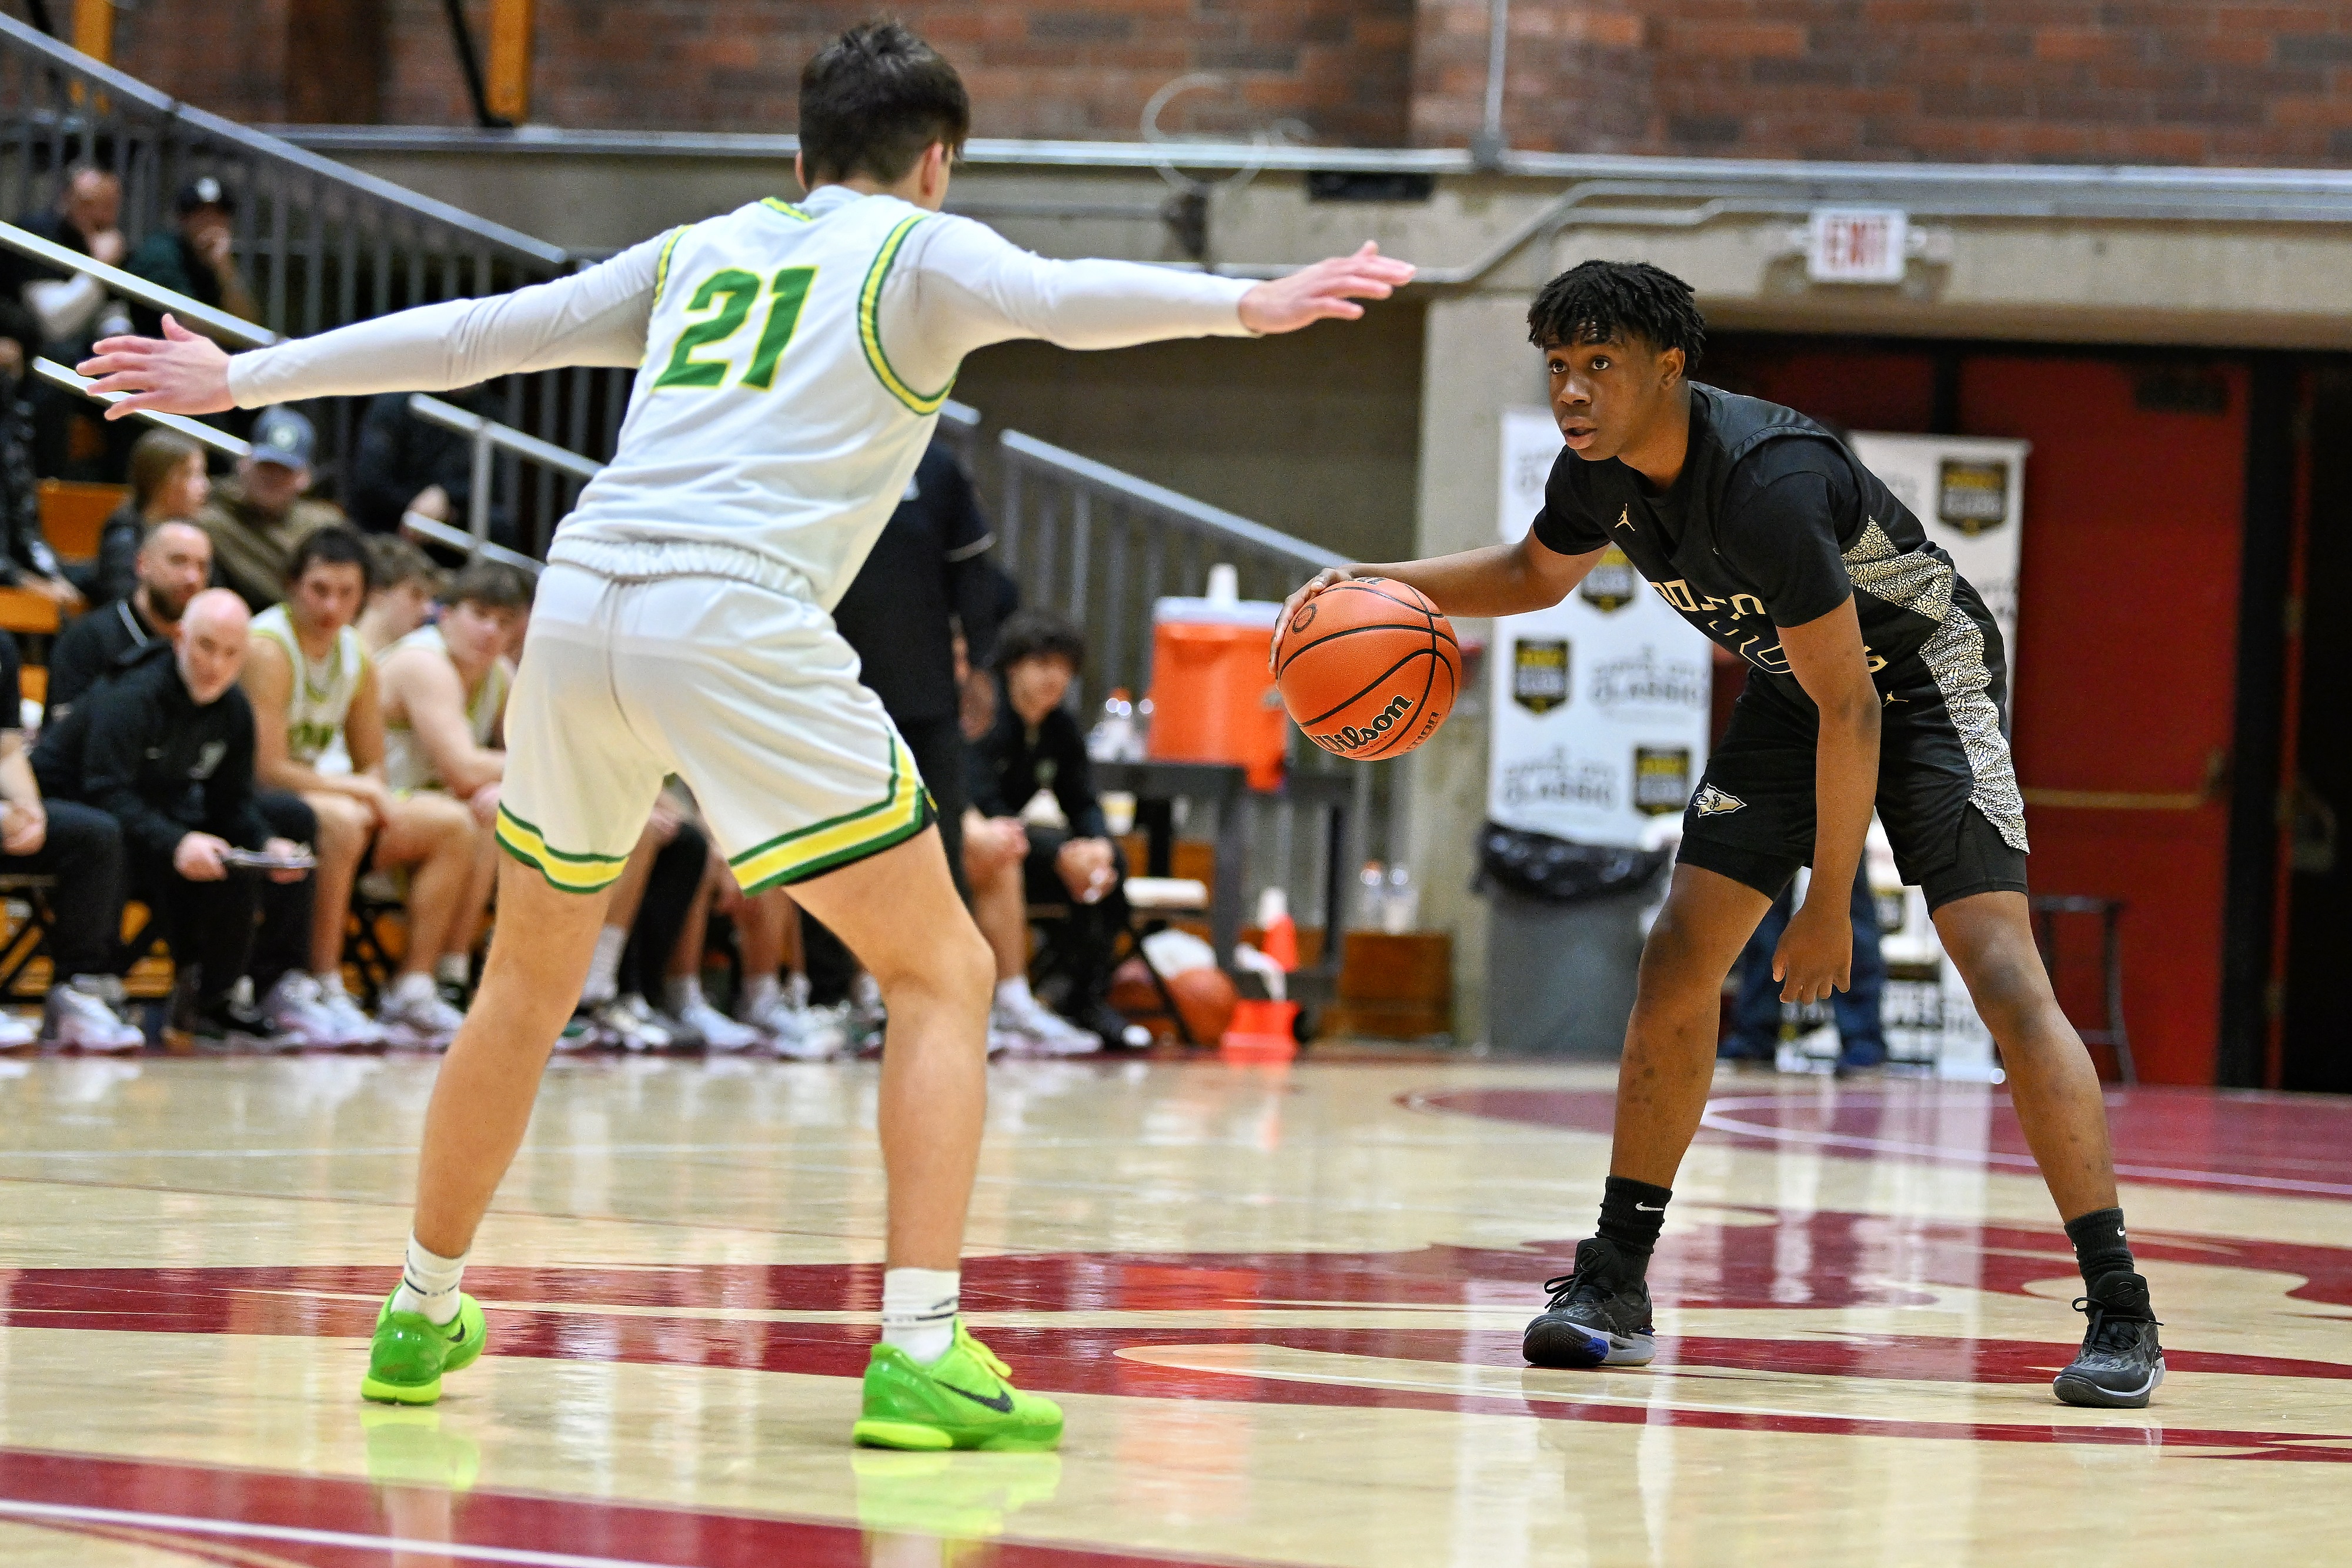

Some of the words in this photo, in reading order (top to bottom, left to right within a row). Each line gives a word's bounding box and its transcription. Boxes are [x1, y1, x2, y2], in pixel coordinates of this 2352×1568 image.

[1825, 218, 1887, 266] EXIT
[649, 265, 820, 393] 21
[1310, 694, 1414, 753] Wilson
